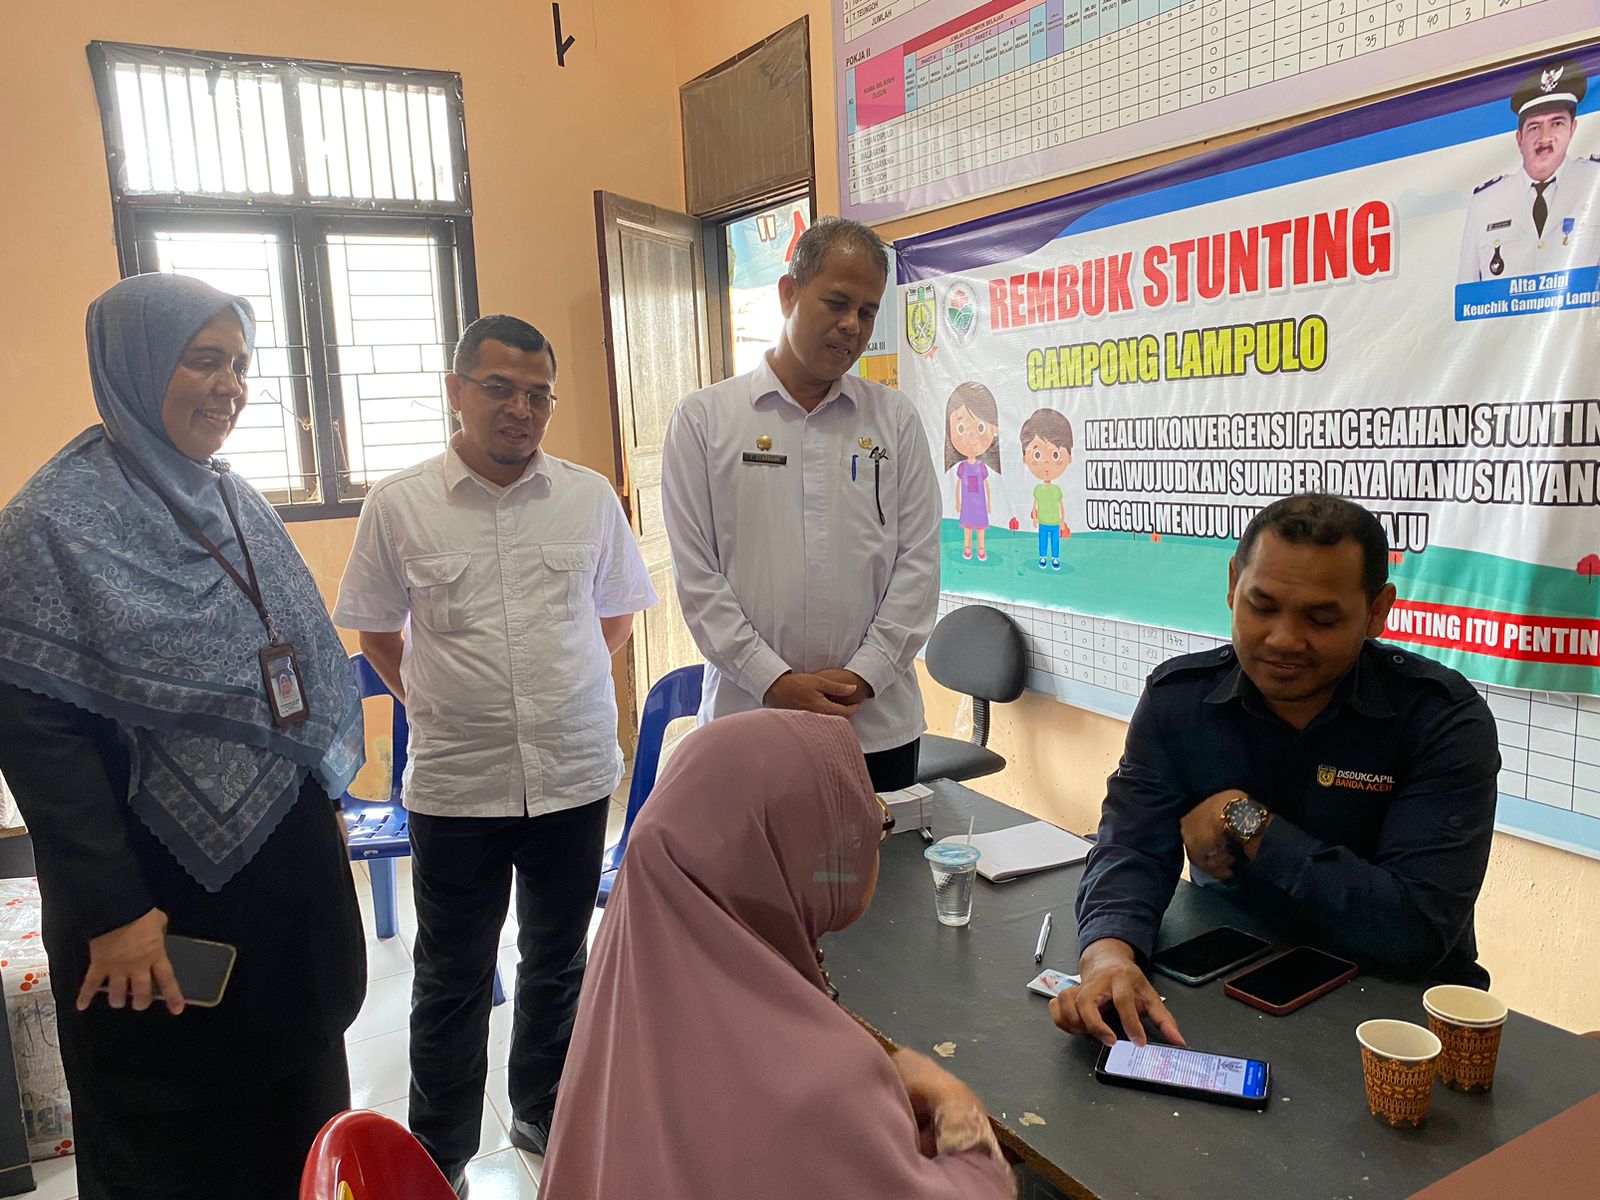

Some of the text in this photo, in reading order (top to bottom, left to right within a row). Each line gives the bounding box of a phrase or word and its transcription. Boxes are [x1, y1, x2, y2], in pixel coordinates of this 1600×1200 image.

[871, 9, 892, 26] JUMLAH
[846, 48, 871, 67] POKJA II
[989, 252, 1133, 330] REMBUK
[1143, 200, 1391, 307] STUNTING
[1509, 272, 1569, 294] Alta Zaini
[1463, 300, 1508, 316] Keuchik
[1511, 294, 1563, 311] Gampong
[1026, 314, 1328, 391] GAMPONG LAMPULO
[1086, 418, 1154, 450] MELALUI
[1157, 413, 1294, 450] KONVERGENSI
[1297, 405, 1469, 449] PENCEGAHAN
[1086, 460, 1123, 491] KITA
[1124, 460, 1227, 495] WUJUDKAN
[1229, 459, 1323, 496] SUMBER
[1325, 460, 1388, 501] DAYA
[1391, 459, 1524, 504] MANUSIA
[1086, 499, 1153, 533] UNGGUL
[1155, 502, 1230, 540] MENUJU
[1376, 511, 1429, 554] AJU
[1387, 607, 1599, 657] UNTING ITU PENTIN
[1335, 778, 1393, 791] BANDA ACEH
[1337, 770, 1395, 783] DISDUKCAPIL
